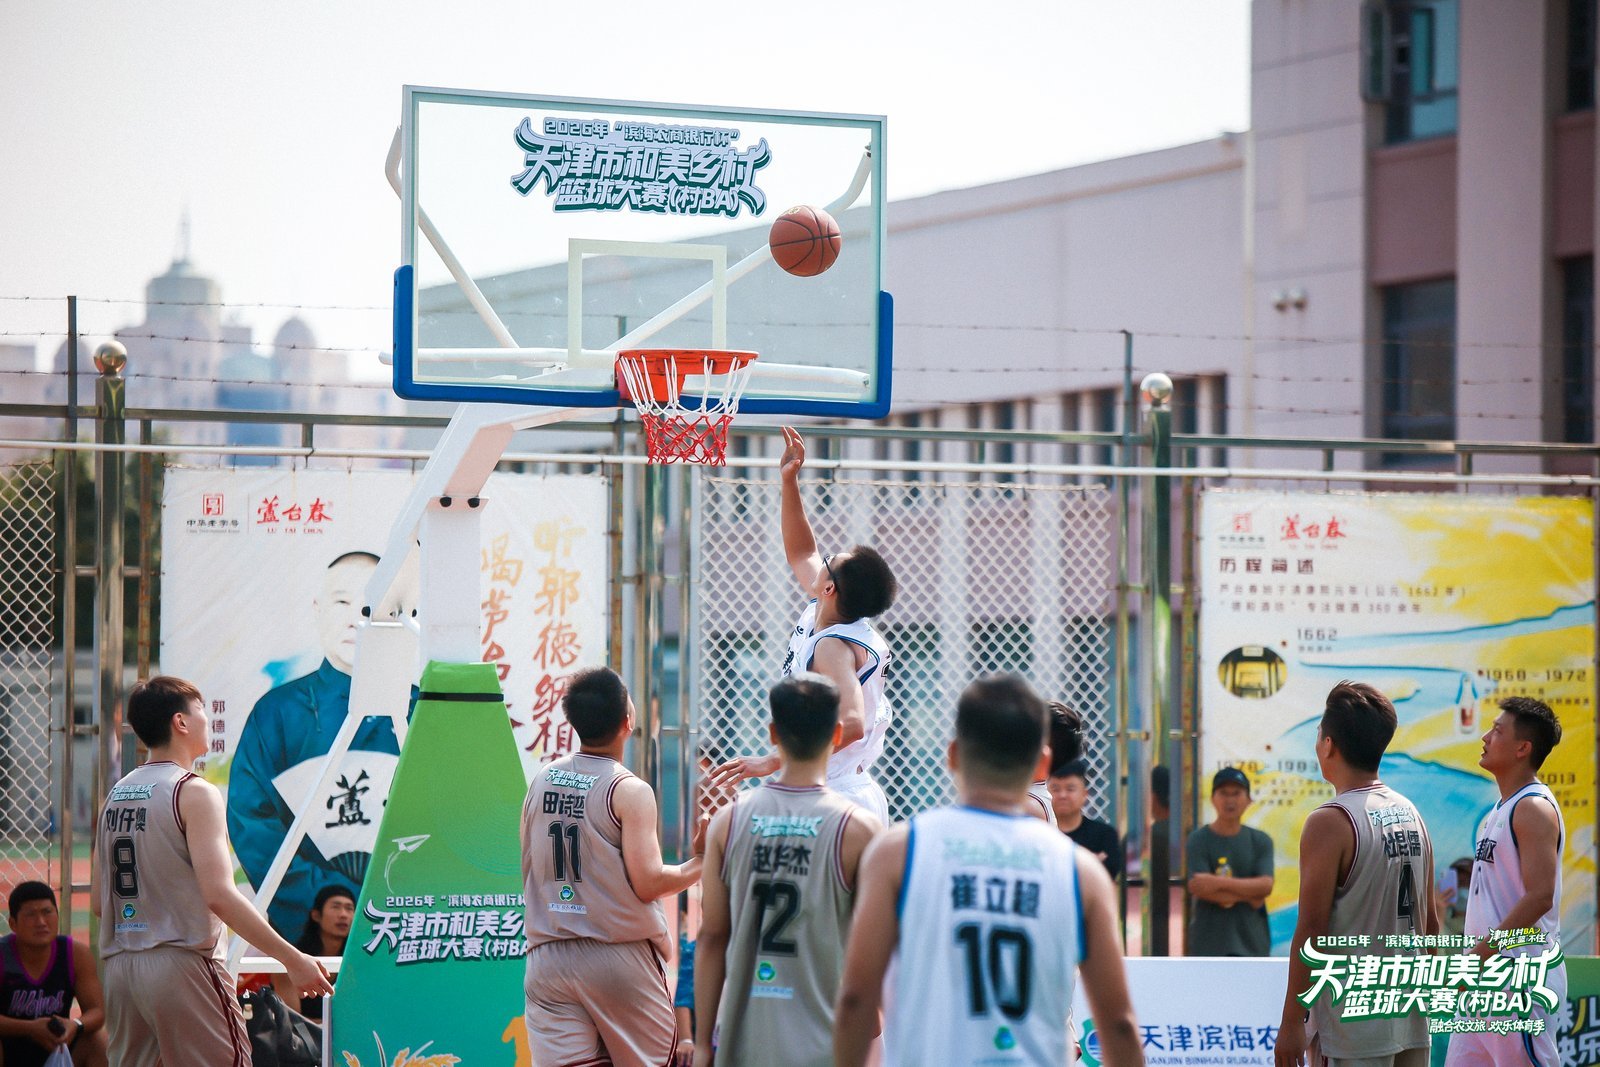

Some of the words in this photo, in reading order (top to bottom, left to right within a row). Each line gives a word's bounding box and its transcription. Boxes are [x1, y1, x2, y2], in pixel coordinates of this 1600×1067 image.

[511, 117, 771, 217] 天津市和美乡村
[1220, 558, 1313, 574] 历程简述
[1297, 628, 1337, 641] 1662
[211, 700, 226, 753] 郭德纲
[112, 836, 140, 899] 8
[548, 820, 582, 882] 11
[362, 899, 527, 953] 天津市和美乡
[751, 880, 801, 958] 12
[954, 921, 1033, 1024] 10
